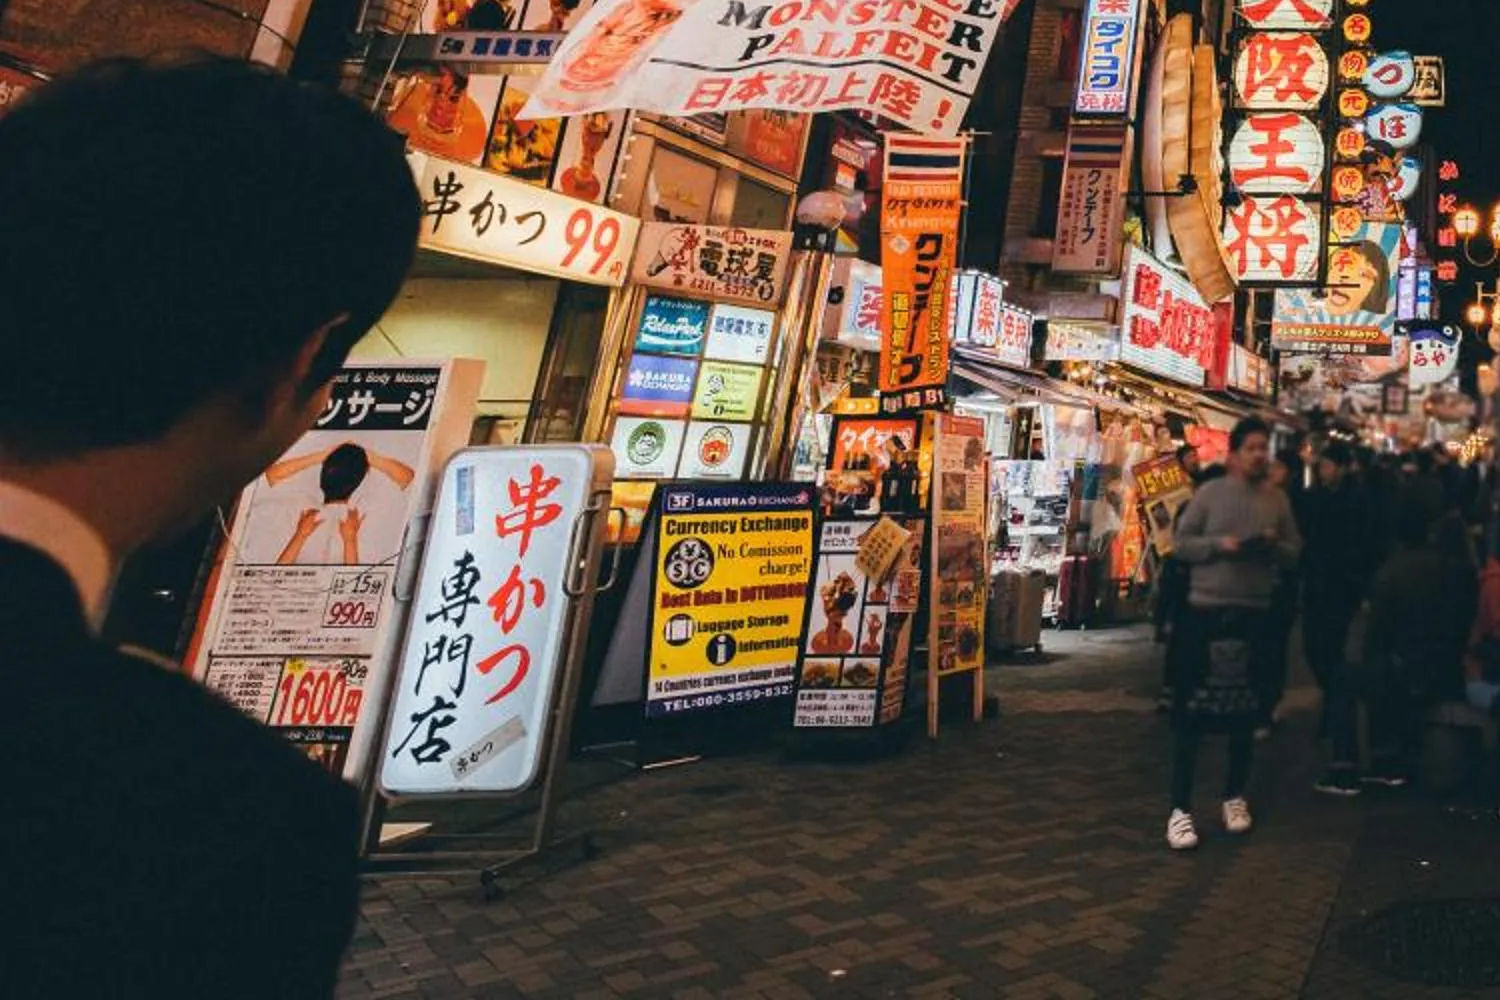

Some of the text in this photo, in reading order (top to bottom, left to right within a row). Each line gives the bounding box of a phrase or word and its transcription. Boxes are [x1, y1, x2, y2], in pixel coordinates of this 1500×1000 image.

[1079, 93, 1126, 111] 免税
[423, 170, 546, 246] 串かつ
[365, 372, 389, 386] Body
[395, 370, 437, 384] Massage
[316, 388, 434, 427] ッサージ
[669, 494, 693, 508] 3F
[696, 496, 749, 507] SAKURA
[666, 516, 809, 536] Currency Exchange
[717, 544, 736, 560] No
[759, 558, 808, 577] charge!
[351, 574, 384, 597] 15分
[475, 463, 564, 706] 串かつ
[327, 600, 375, 626] 990円
[696, 613, 789, 633] Luggage Storage
[392, 548, 481, 767] 専門店
[277, 669, 364, 726] 1600円
